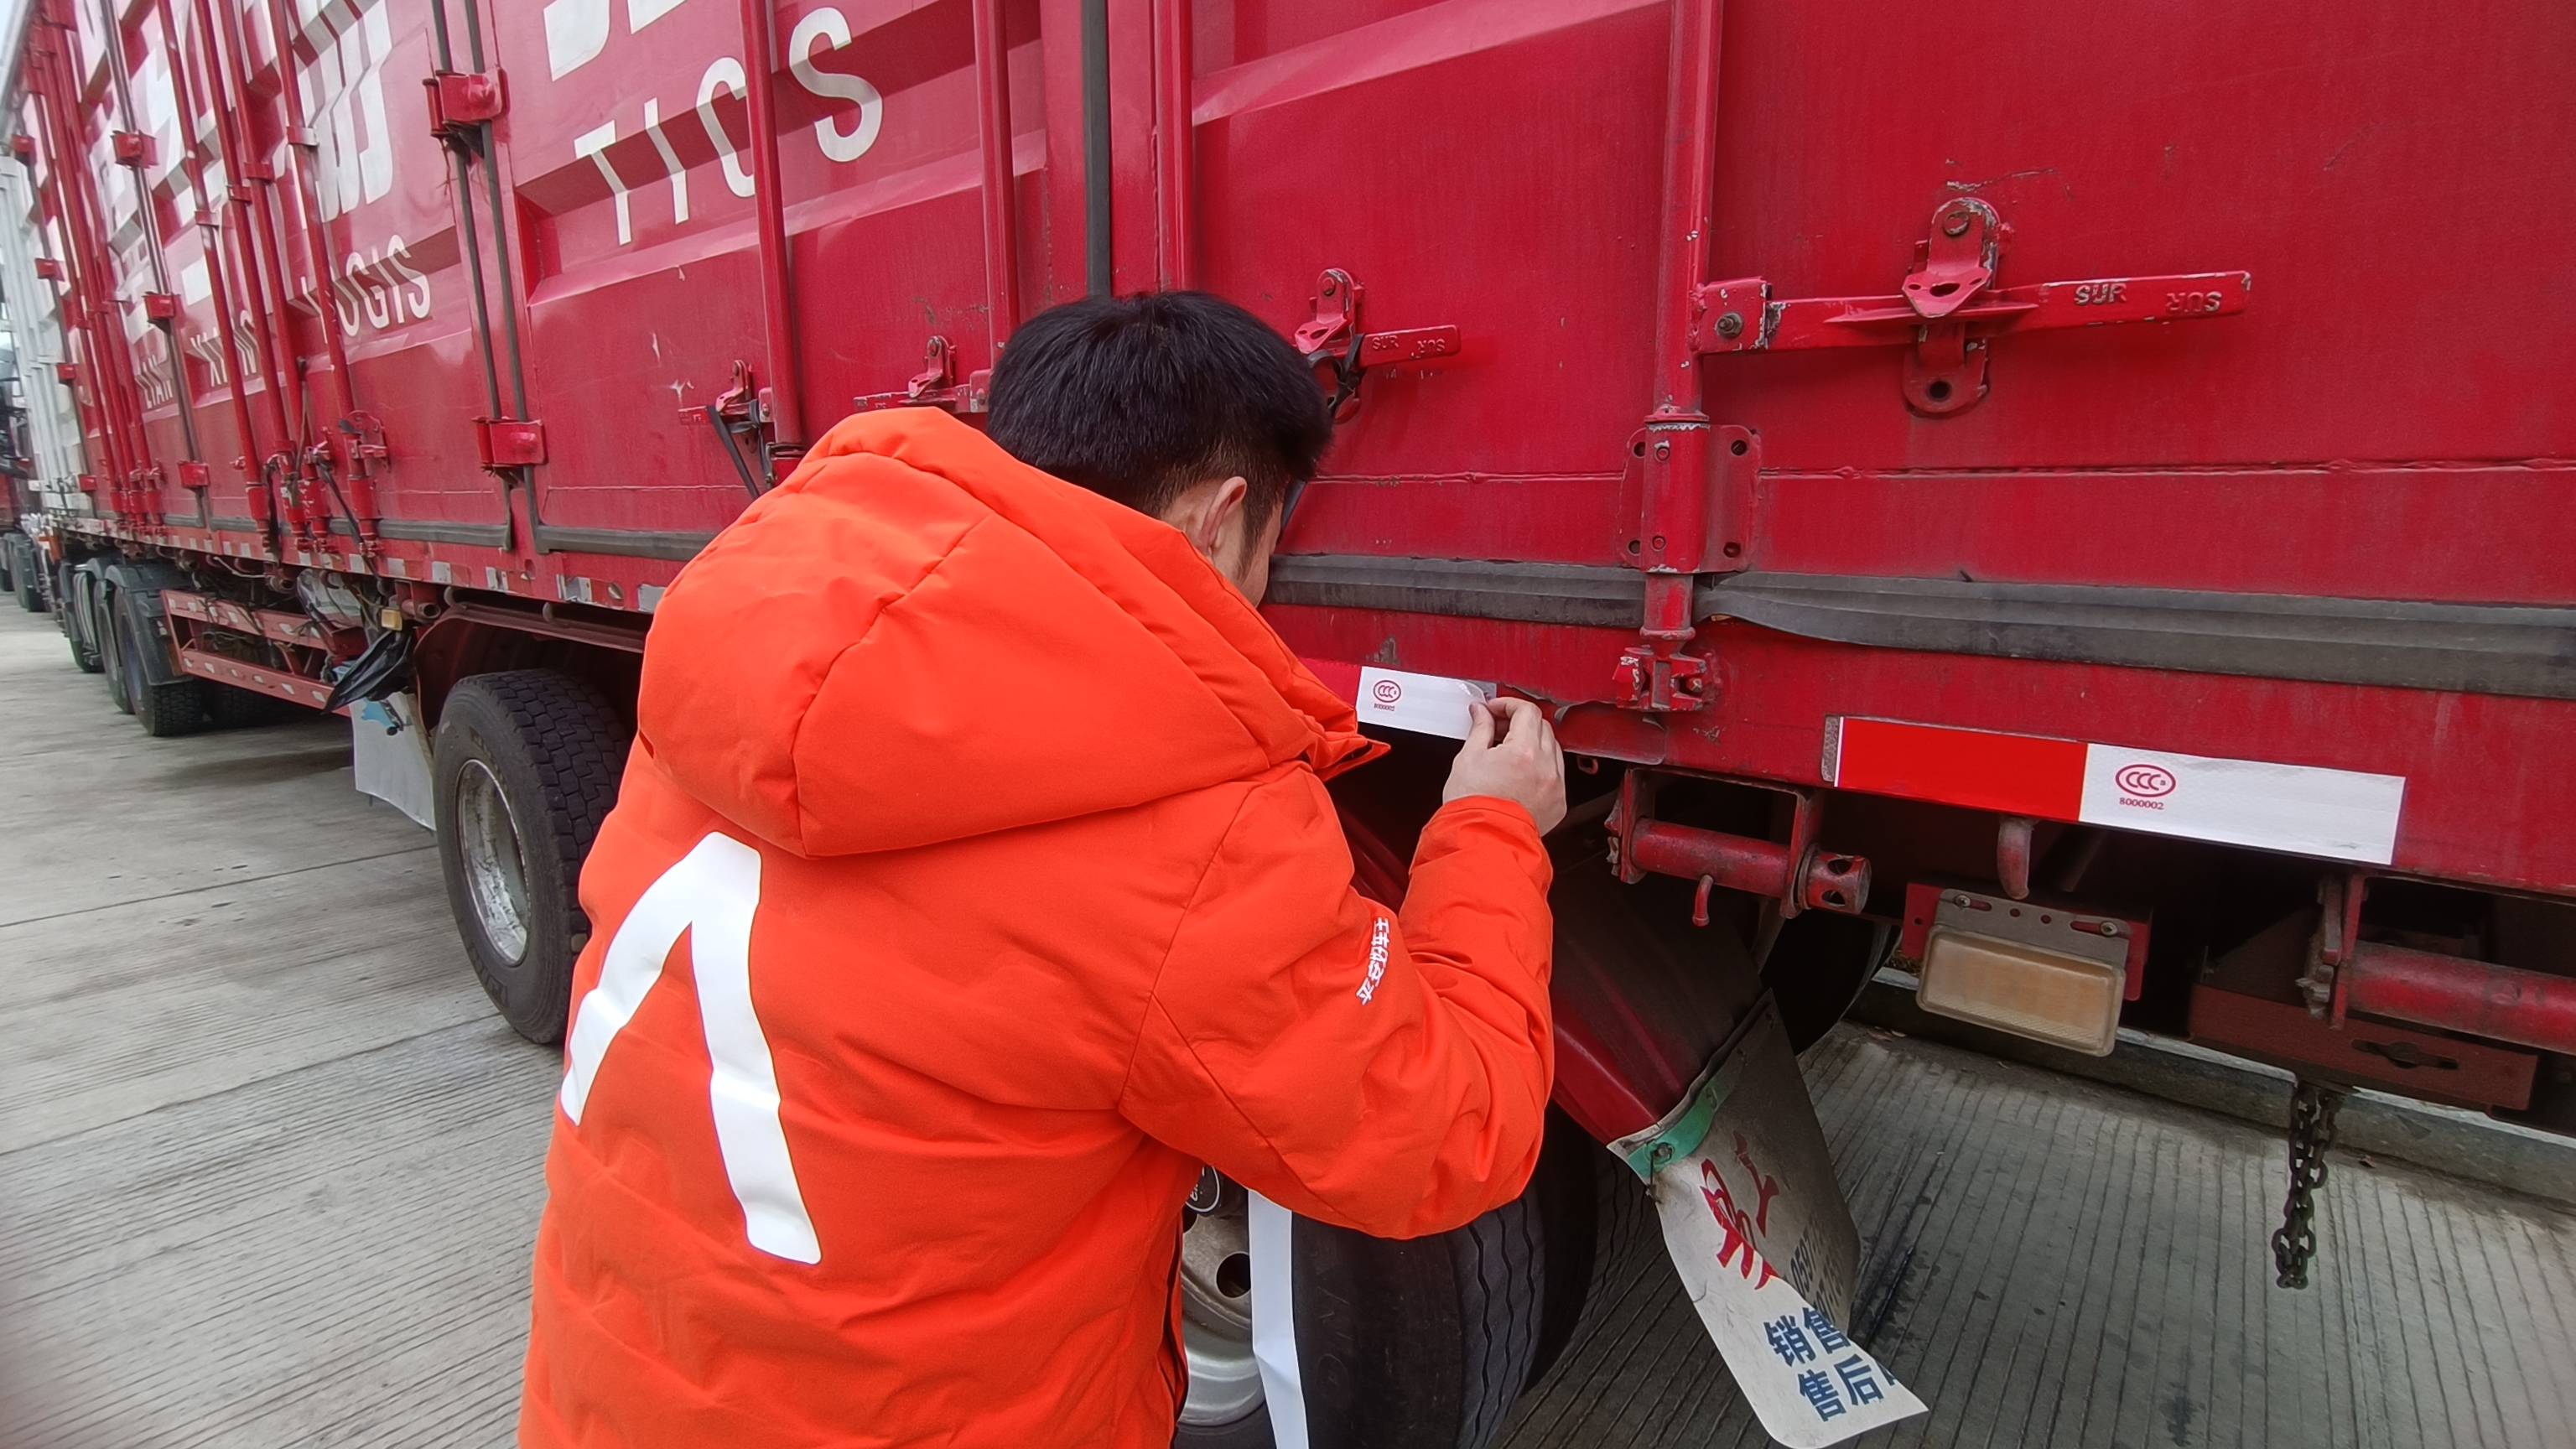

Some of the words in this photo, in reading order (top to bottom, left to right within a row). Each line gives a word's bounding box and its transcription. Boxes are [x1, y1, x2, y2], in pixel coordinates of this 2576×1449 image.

[574, 6, 883, 246] TICS
[2074, 283, 2127, 306] SUR
[1356, 917, 1389, 1005] 平安好车主
[1763, 1306, 1852, 1367] 销售
[1797, 1353, 1896, 1422] 售后
